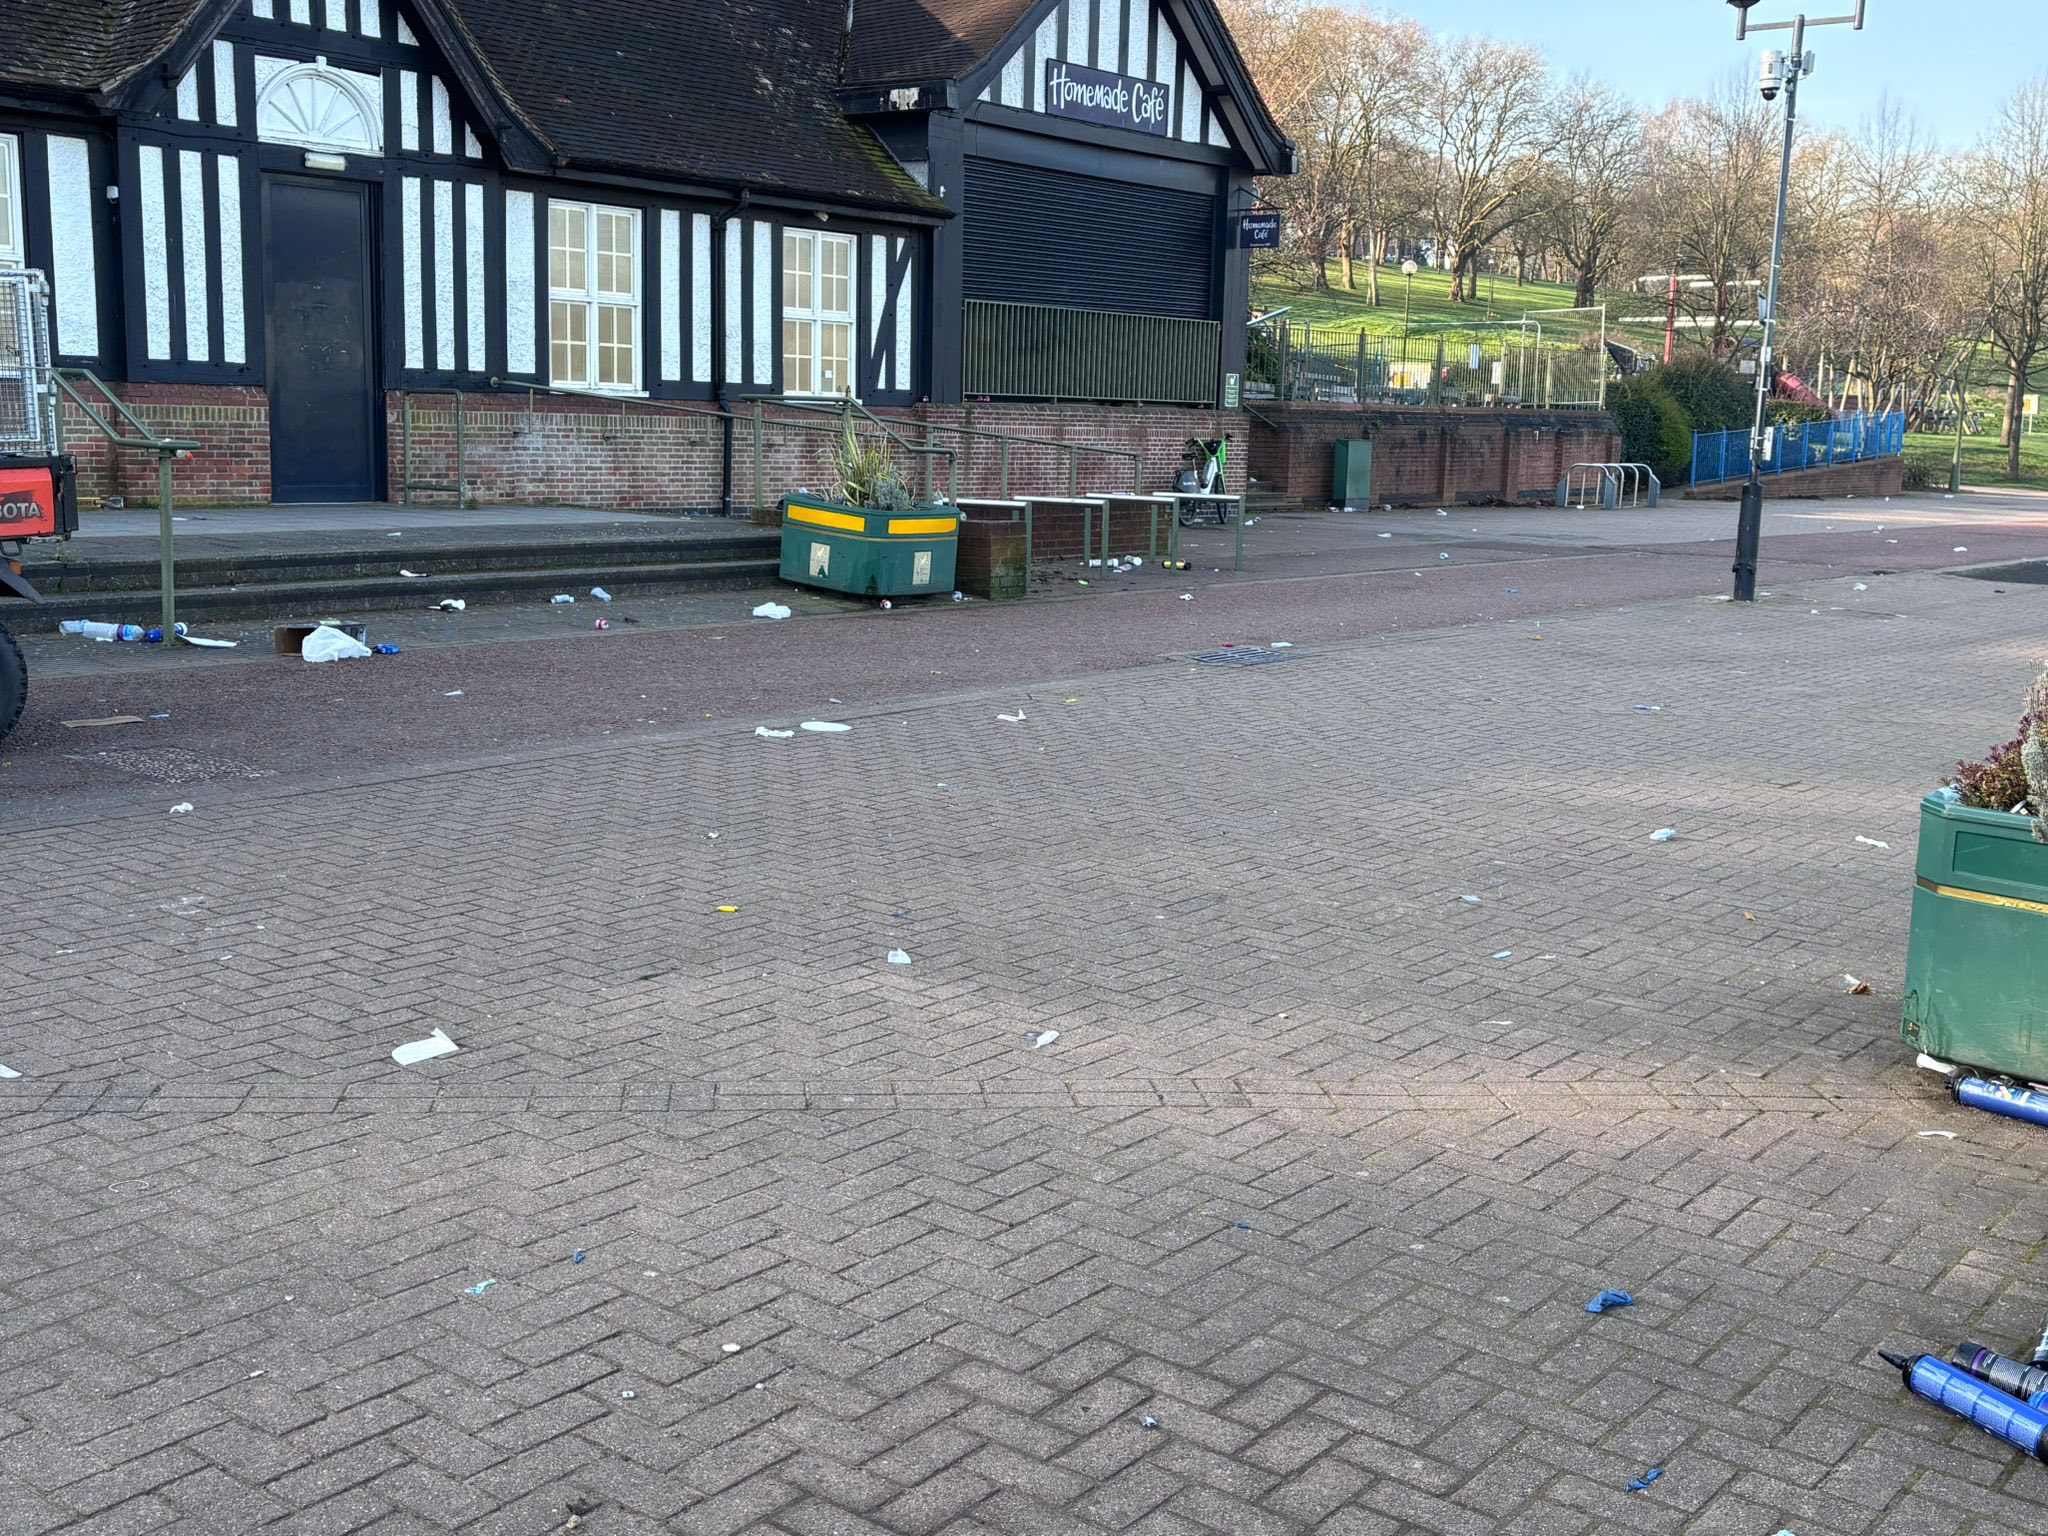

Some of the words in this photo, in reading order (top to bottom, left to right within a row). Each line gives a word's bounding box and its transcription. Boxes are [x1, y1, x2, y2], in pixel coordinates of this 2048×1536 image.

[1049, 64, 1129, 114] Homemade
[1132, 82, 1165, 124] Café
[1254, 229, 1268, 240] Café
[0, 502, 41, 519] OTA
